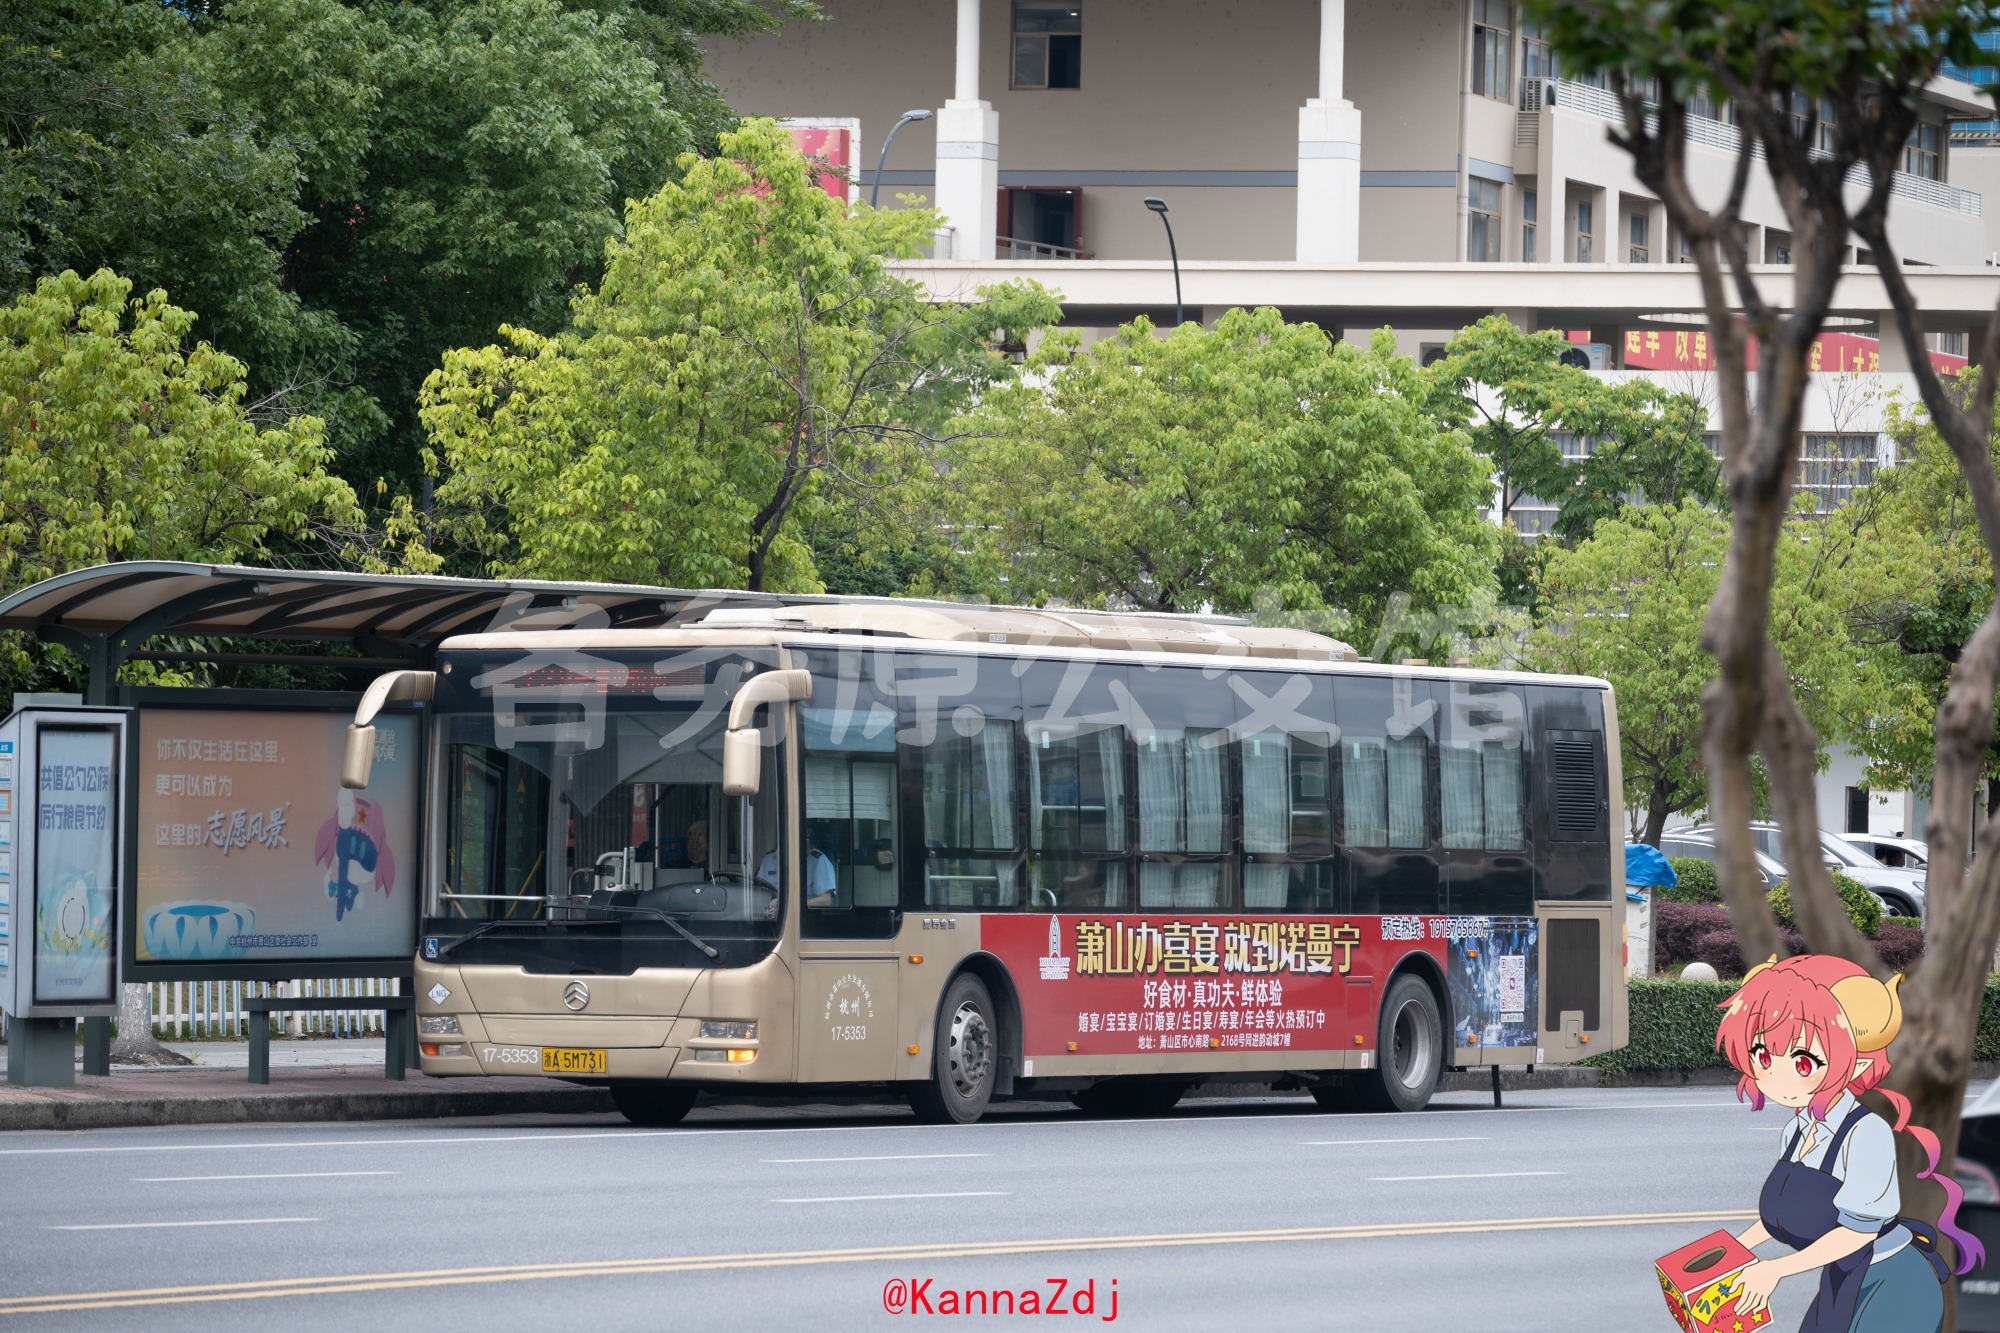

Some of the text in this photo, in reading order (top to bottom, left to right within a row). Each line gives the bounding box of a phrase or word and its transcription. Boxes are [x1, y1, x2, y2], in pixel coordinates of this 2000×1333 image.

[157, 738, 286, 764] 你不仅生活在这里，
[41, 765, 109, 792] 共倡公勺公筷
[155, 774, 233, 797] 更可以成为
[40, 804, 106, 831] 厉行粮食节约
[1075, 920, 1360, 975] 萧山办喜宴 就到诺曼宁
[431, 989, 447, 998] LNG
[1143, 979, 1283, 1008] 好食材·真功夫·鲜体验
[840, 996, 860, 1017] 杭州
[831, 1025, 866, 1040] 17-5353
[1078, 1009, 1326, 1033] 婚宴/宝宝宴/订婚宴/生日宴/寿宴/年会等火热预订中
[482, 1047, 539, 1064] 17-5353
